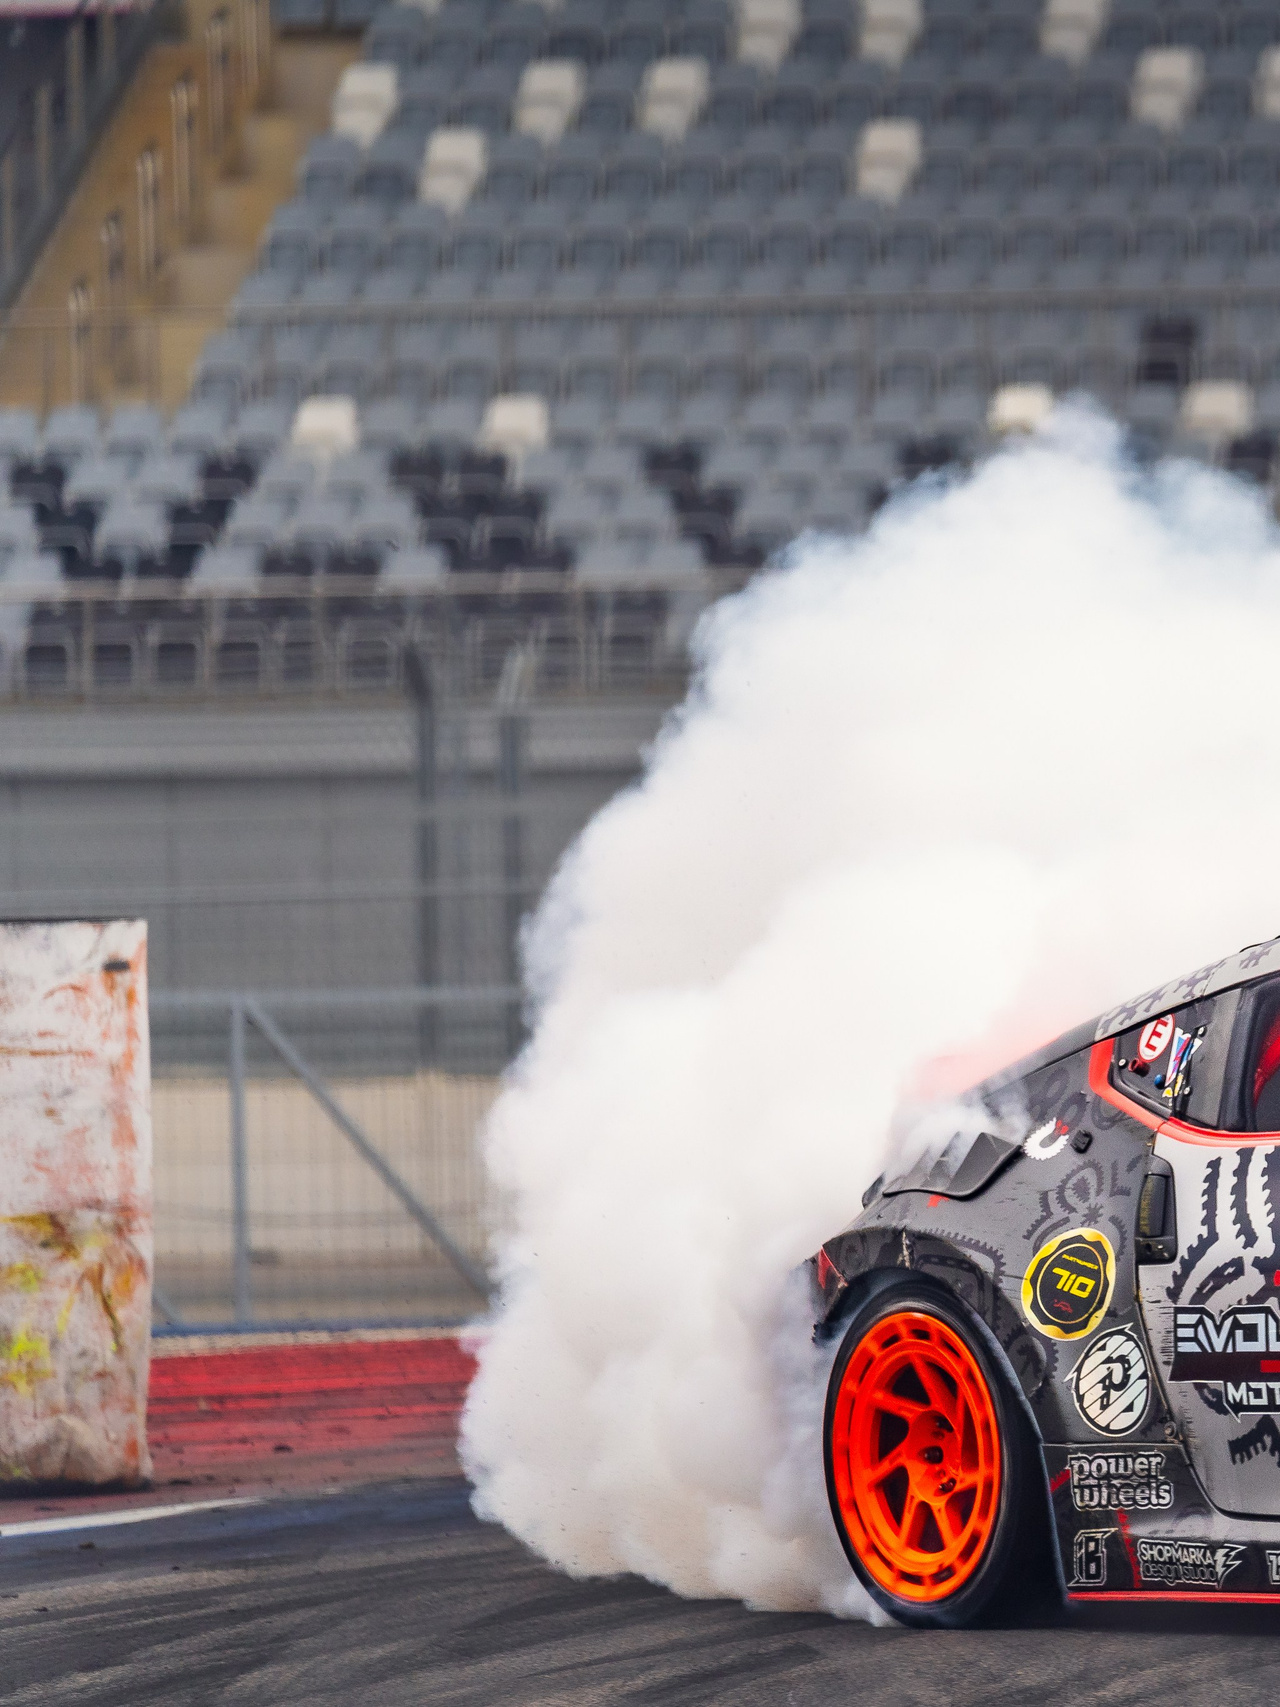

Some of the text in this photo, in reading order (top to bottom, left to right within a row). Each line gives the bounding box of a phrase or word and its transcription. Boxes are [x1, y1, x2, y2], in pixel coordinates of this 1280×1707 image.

[1145, 1018, 1169, 1052] E
[1070, 1454, 1164, 1485] power
[1074, 1480, 1172, 1508] wheels
[1140, 1543, 1215, 1566] SHOPMARKA
